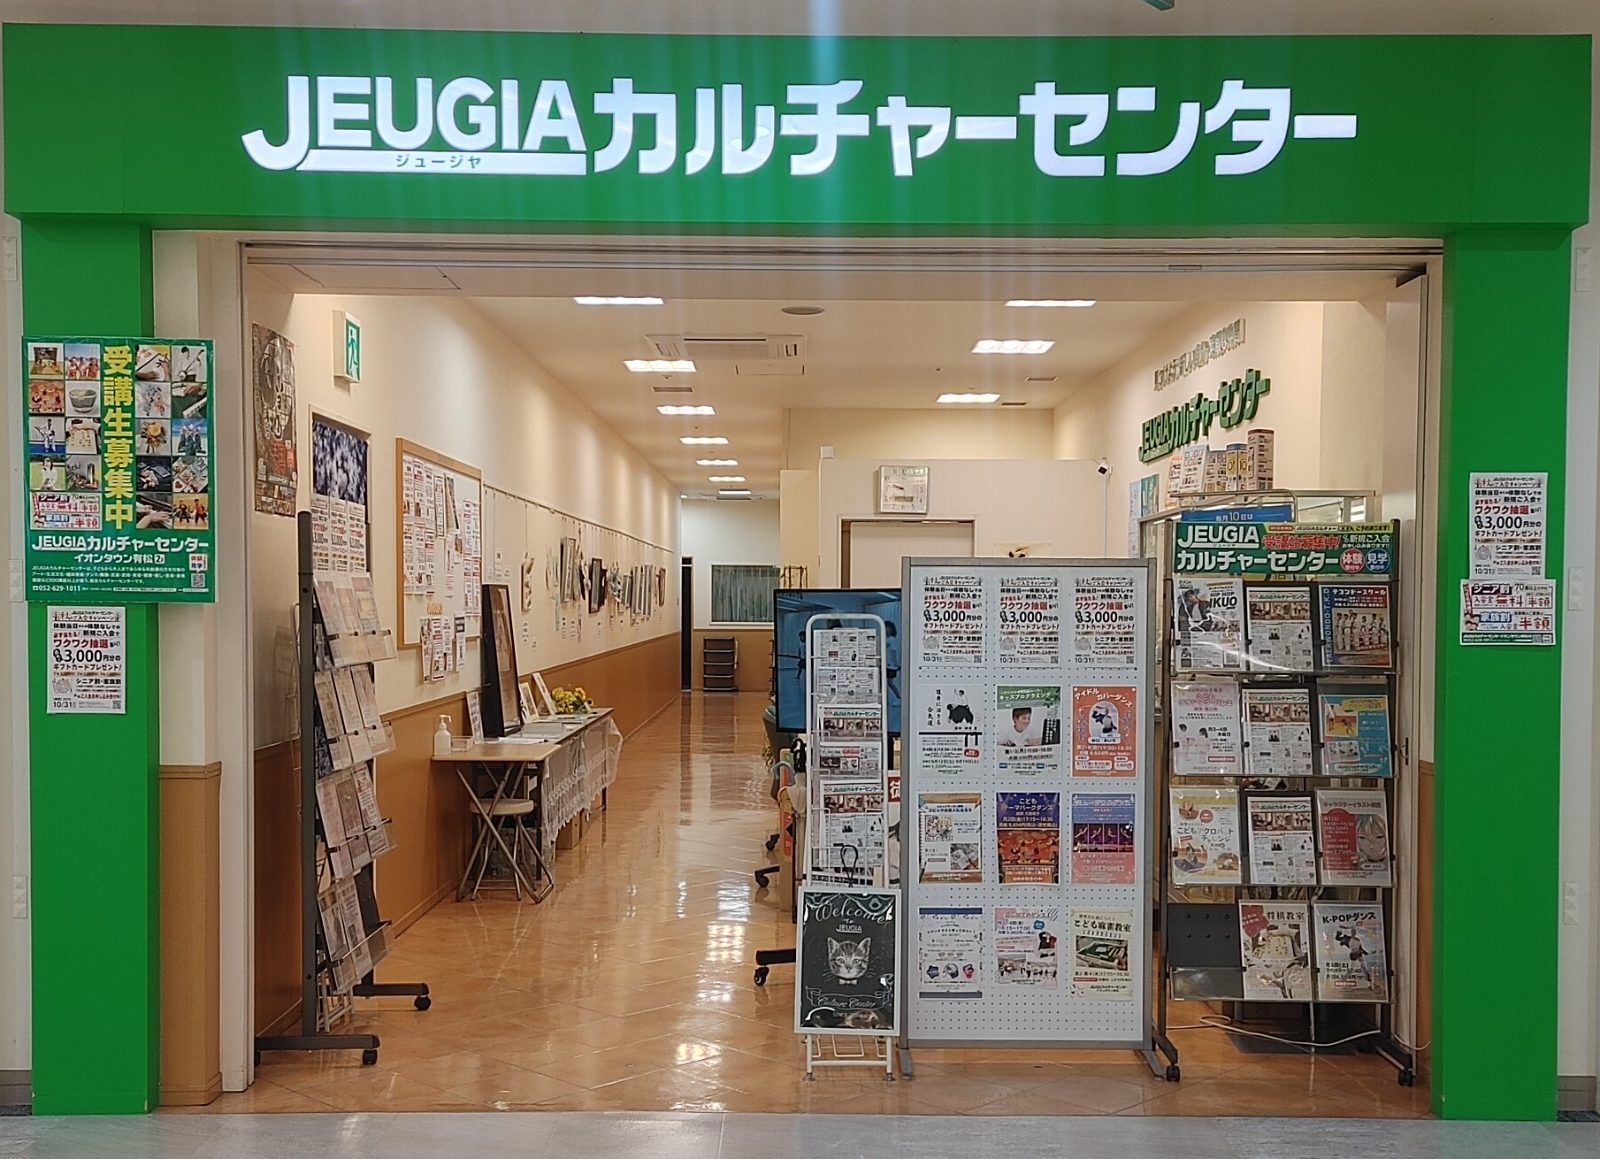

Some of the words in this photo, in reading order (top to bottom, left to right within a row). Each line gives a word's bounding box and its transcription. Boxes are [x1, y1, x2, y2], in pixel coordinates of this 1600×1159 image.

[241, 75, 1357, 176] JEUGIAカルチャーセンター
[103, 345, 134, 530] 受講生募集中
[32, 535, 209, 552] JEUGIAカルチャーセンター
[1178, 525, 1259, 549] JEUGIA
[74, 553, 153, 564] イオンタウン有松
[1176, 551, 1339, 572] カルチャーセンター
[1342, 553, 1362, 564] 体験
[1368, 552, 1388, 564] 見学
[1210, 596, 1238, 608] IKUO
[1520, 617, 1550, 630] 半額
[1000, 692, 1051, 700] キッズプログラミング
[816, 898, 886, 924] Welcome
[1322, 912, 1376, 924] K-POPダンス
